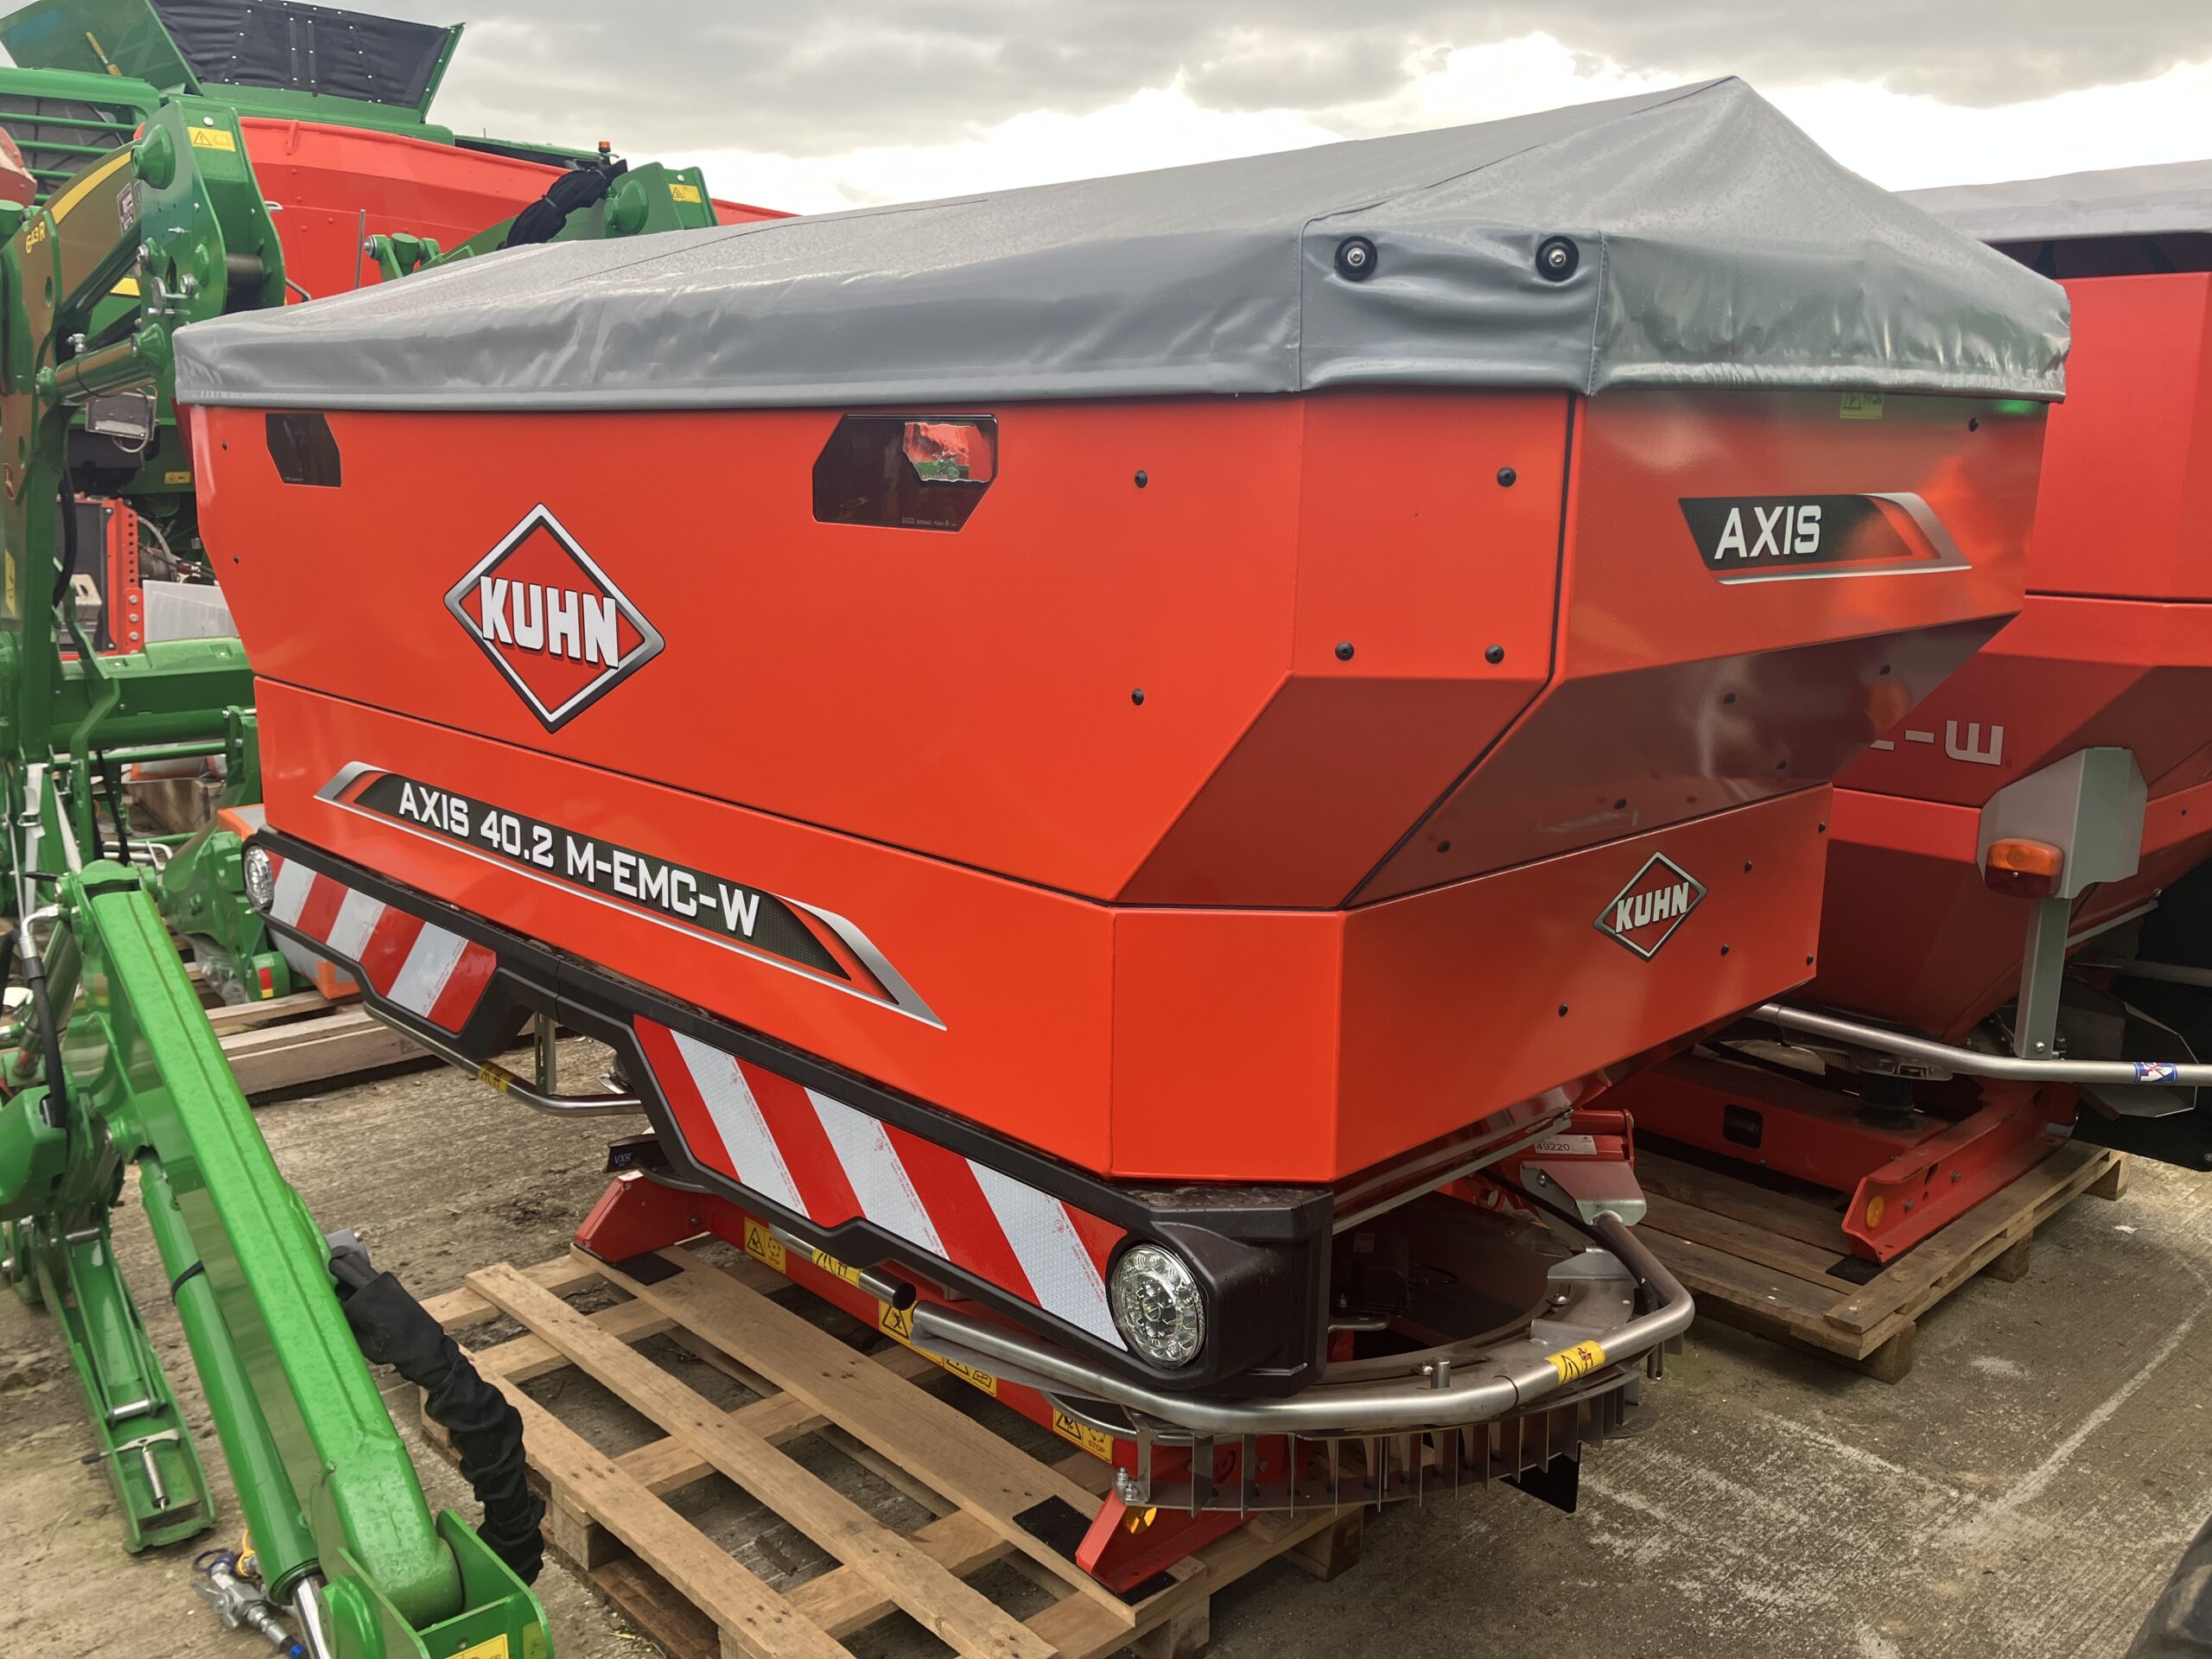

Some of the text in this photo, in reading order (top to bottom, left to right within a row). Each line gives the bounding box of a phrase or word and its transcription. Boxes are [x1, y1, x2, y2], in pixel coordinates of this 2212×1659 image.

[1713, 505, 1821, 560] AXIS
[480, 575, 620, 669] KUHN
[398, 782, 760, 938] AXIS 40.2 M-EMC-W
[1615, 881, 1689, 933] KUHN
[614, 1153, 632, 1165] VXR
[1088, 1440, 1105, 1453] STOP
